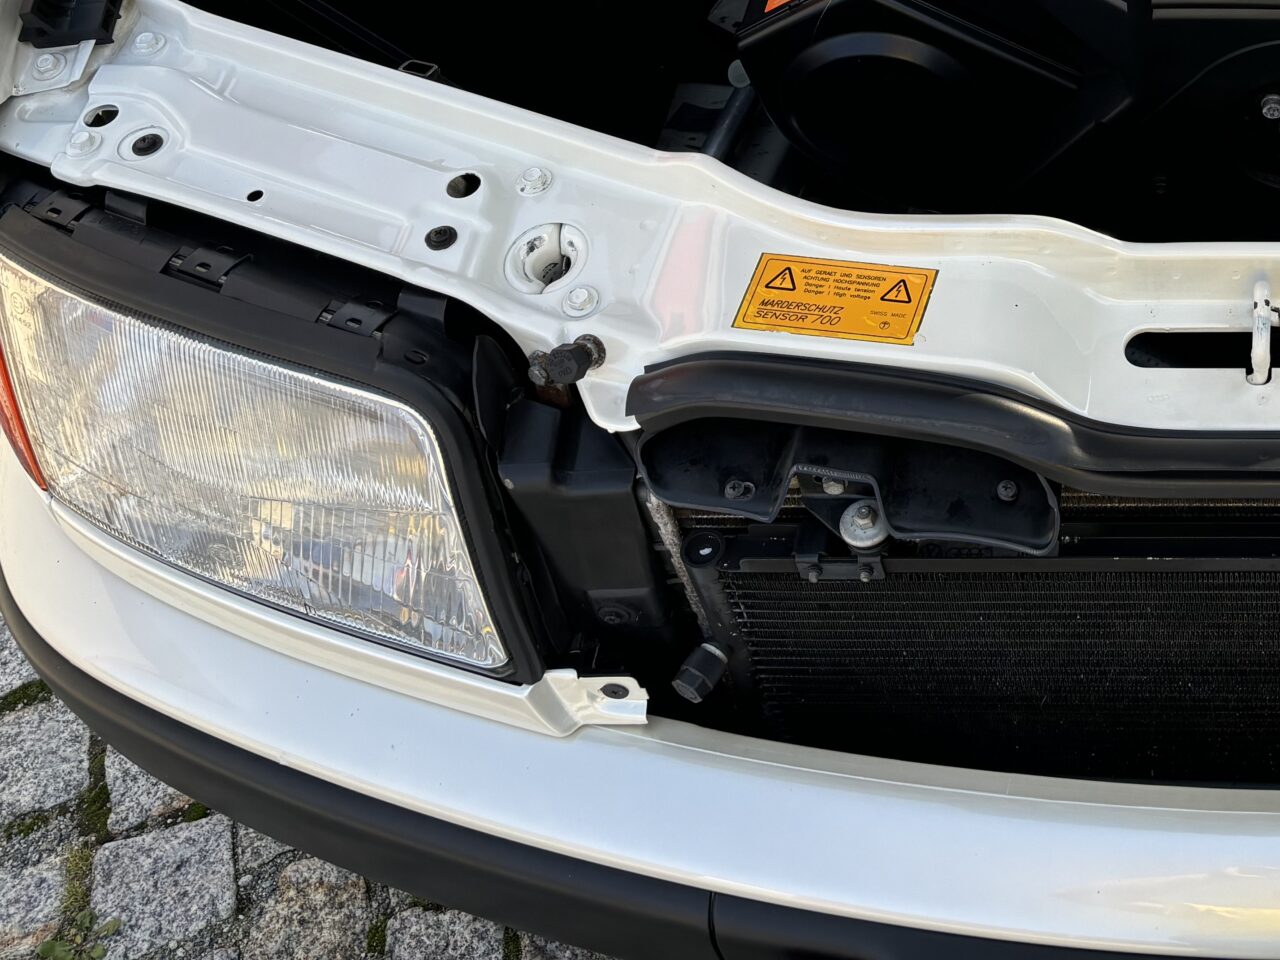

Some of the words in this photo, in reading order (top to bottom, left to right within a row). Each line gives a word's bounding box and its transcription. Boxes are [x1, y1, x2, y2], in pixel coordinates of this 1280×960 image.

[833, 279, 880, 287] HOCHSPANNUNG
[856, 274, 887, 282] SENSOREN
[759, 299, 844, 315] MARDERSCHUTZ
[753, 310, 809, 323] SENSOR
[813, 314, 842, 326] 700
